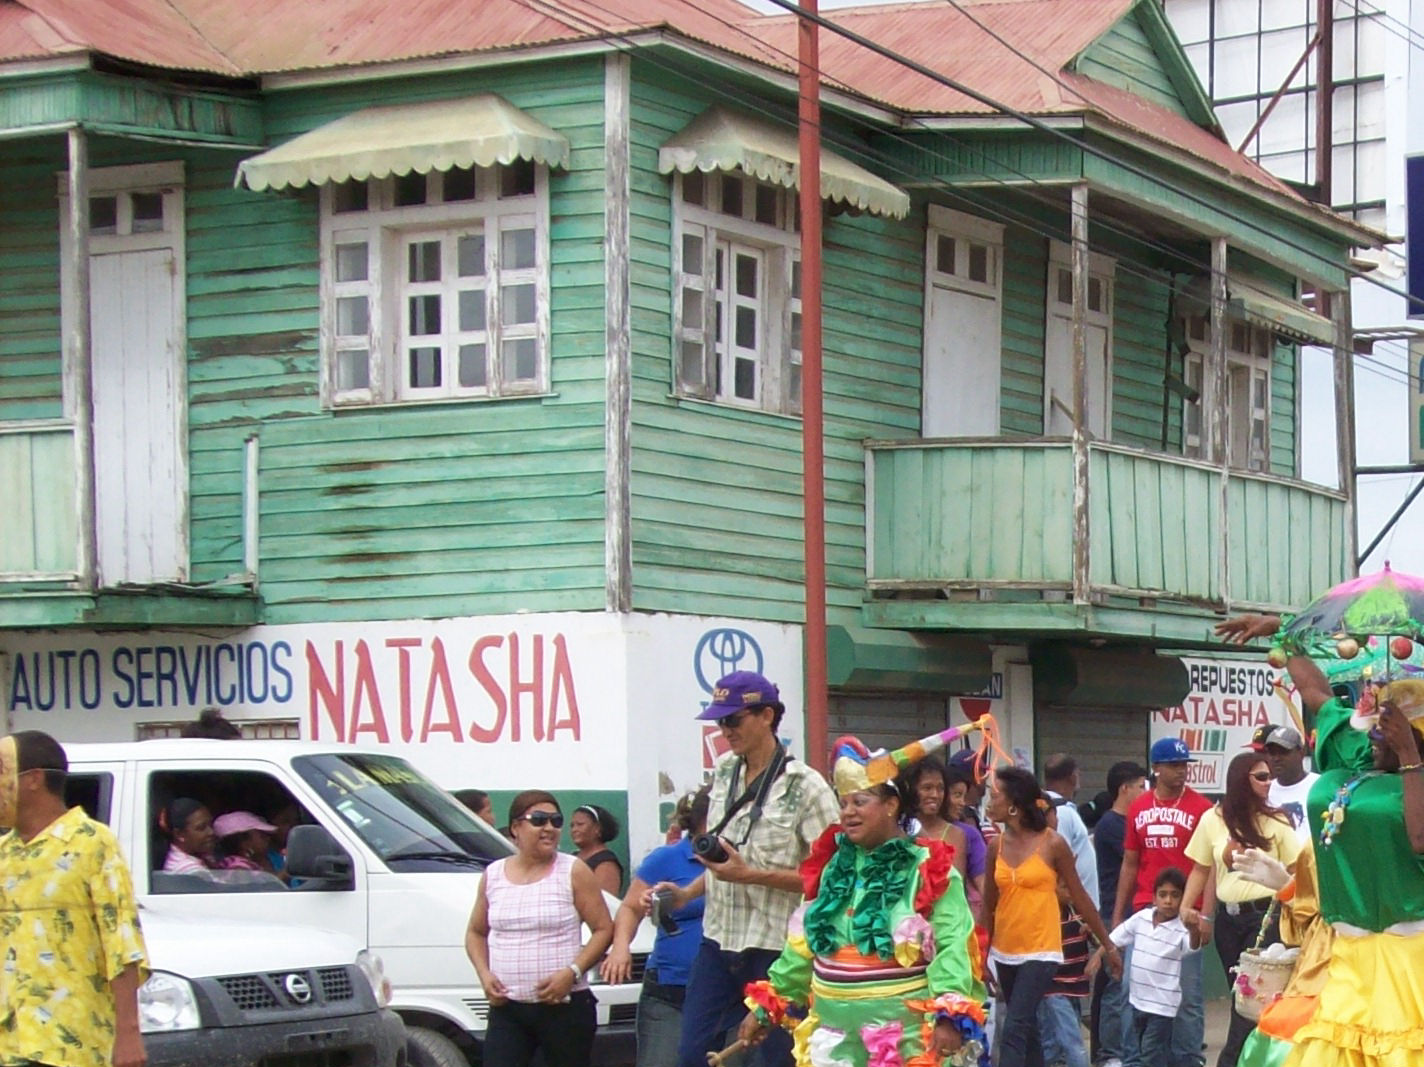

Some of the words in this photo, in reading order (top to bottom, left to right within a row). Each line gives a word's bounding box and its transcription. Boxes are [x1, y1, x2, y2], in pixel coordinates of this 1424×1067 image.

[10, 648, 101, 711] AUTO
[112, 641, 293, 709] SERVICIOS
[305, 631, 581, 744] NATASHA
[1190, 664, 1274, 697] REPUESTOS
[1186, 760, 1217, 784] astrol
[1134, 807, 1195, 830] AEROPOSTALE
